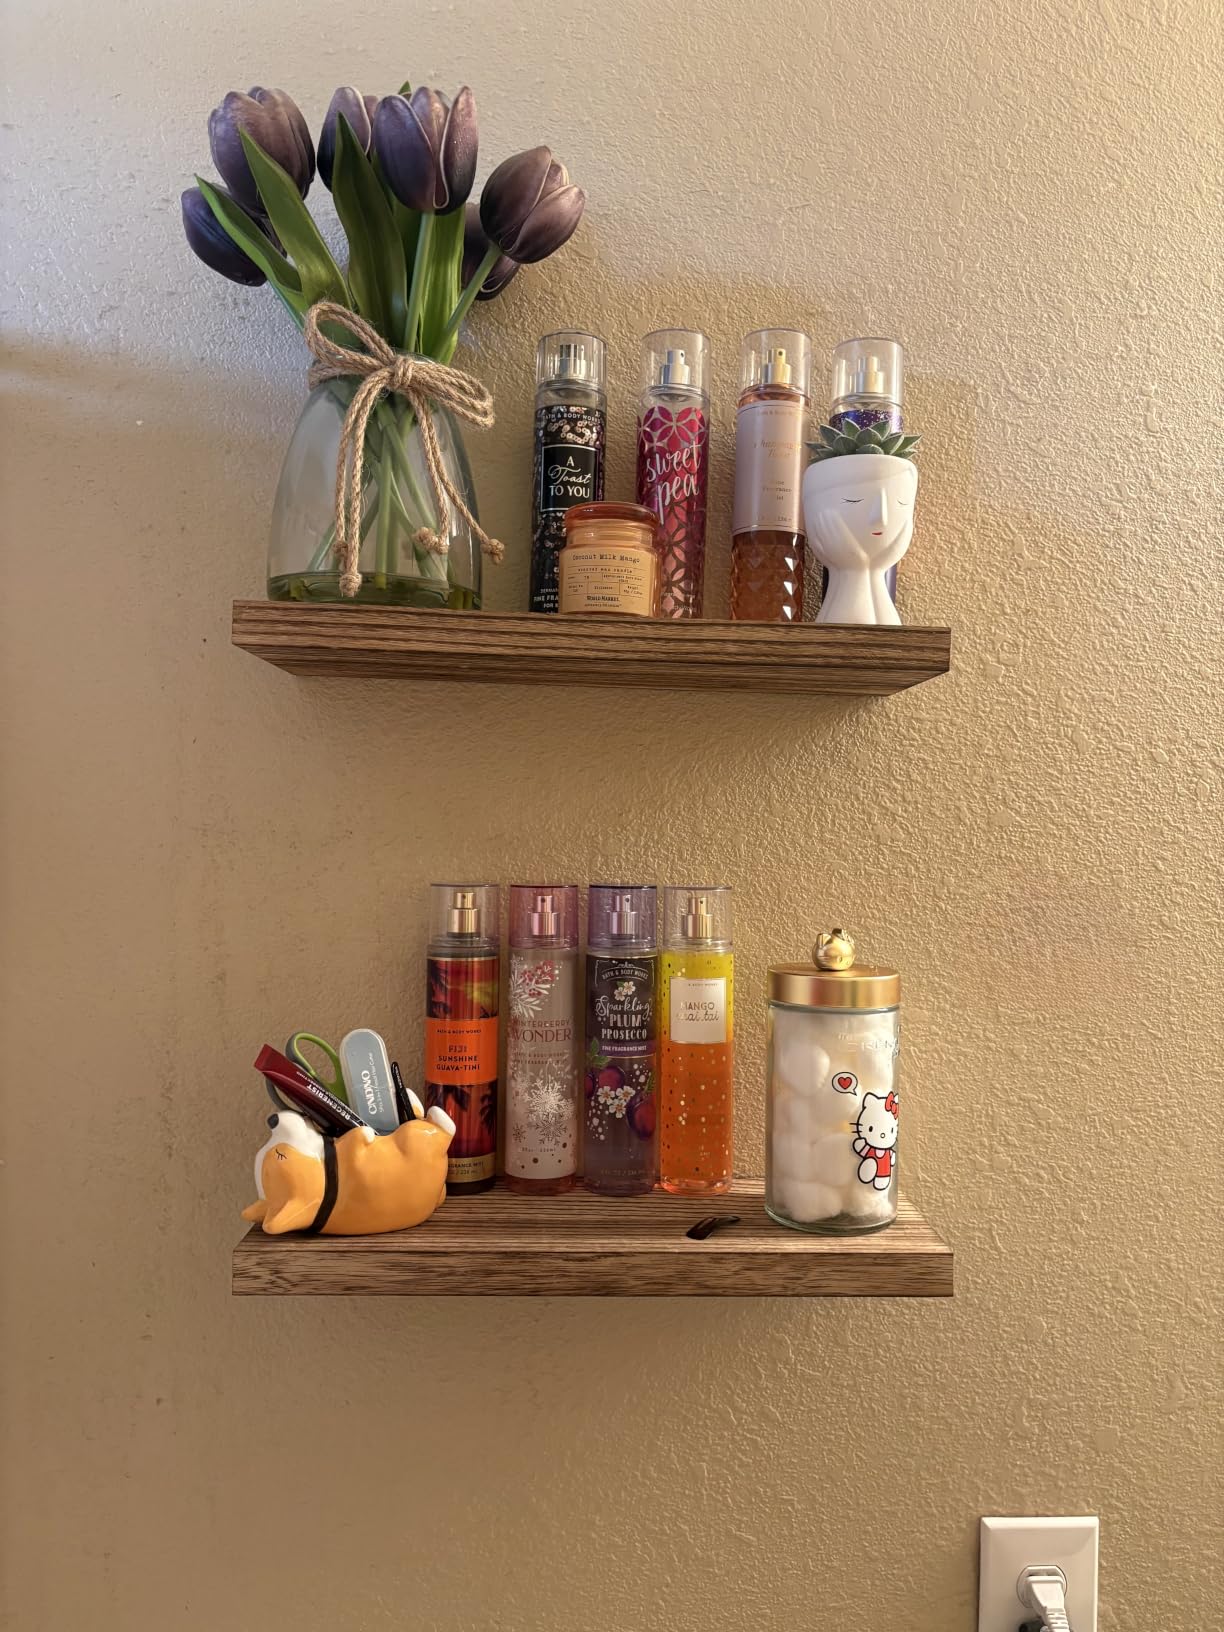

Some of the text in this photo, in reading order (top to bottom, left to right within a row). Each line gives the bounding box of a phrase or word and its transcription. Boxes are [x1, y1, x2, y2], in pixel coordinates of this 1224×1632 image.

[566, 455, 575, 467] A
[646, 440, 702, 482] sweet
[548, 465, 592, 485] Toast
[549, 485, 590, 499] TO YOU
[657, 473, 700, 525] pea
[595, 995, 652, 1020] Sparkling
[609, 1013, 642, 1027] PLUM
[511, 1028, 571, 1042] WONDER
[601, 1028, 647, 1040] PROSECCO
[306, 1084, 351, 1120] REGENERIST
